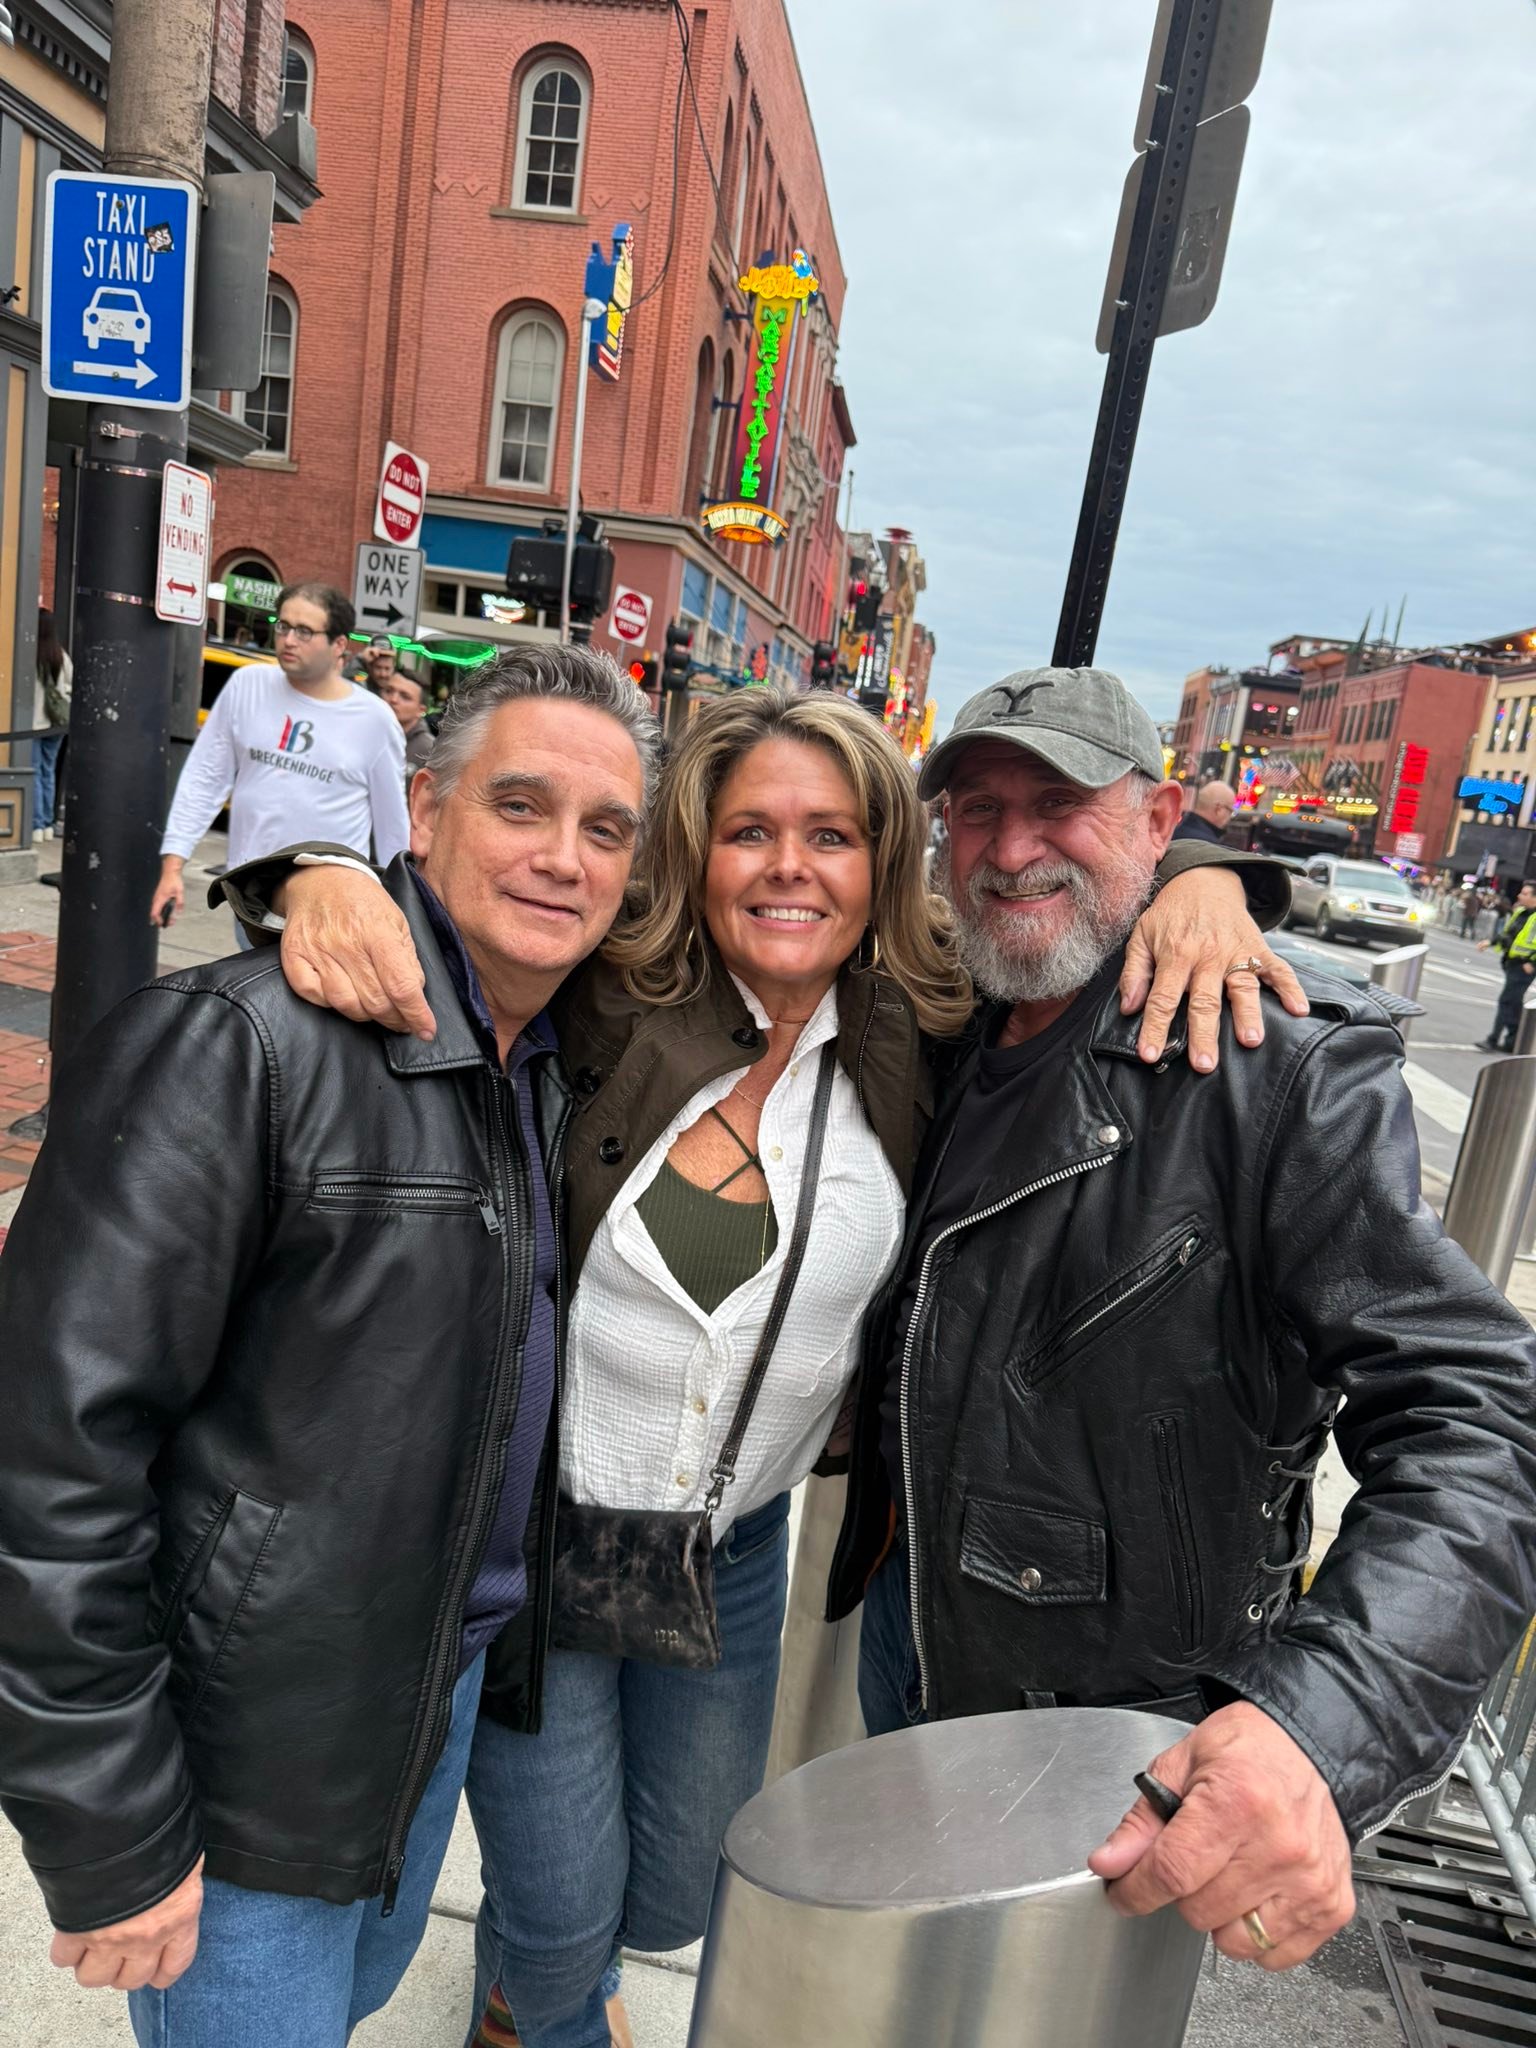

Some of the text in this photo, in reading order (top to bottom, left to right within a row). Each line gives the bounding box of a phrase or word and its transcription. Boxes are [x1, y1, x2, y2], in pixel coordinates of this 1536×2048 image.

[96, 191, 145, 236] TAXI
[82, 236, 155, 283] STAND
[740, 304, 787, 498] MARGARITAVILLE
[389, 464, 420, 493] DO NOT
[180, 492, 193, 517] NO
[386, 505, 412, 530] ENTER
[165, 523, 204, 556] VENDING
[367, 551, 410, 575] ONE
[364, 574, 409, 599] WAY
[620, 599, 646, 616] DO NOT
[617, 619, 640, 636] ENTER
[249, 747, 336, 784] BRECKENRIDGE
